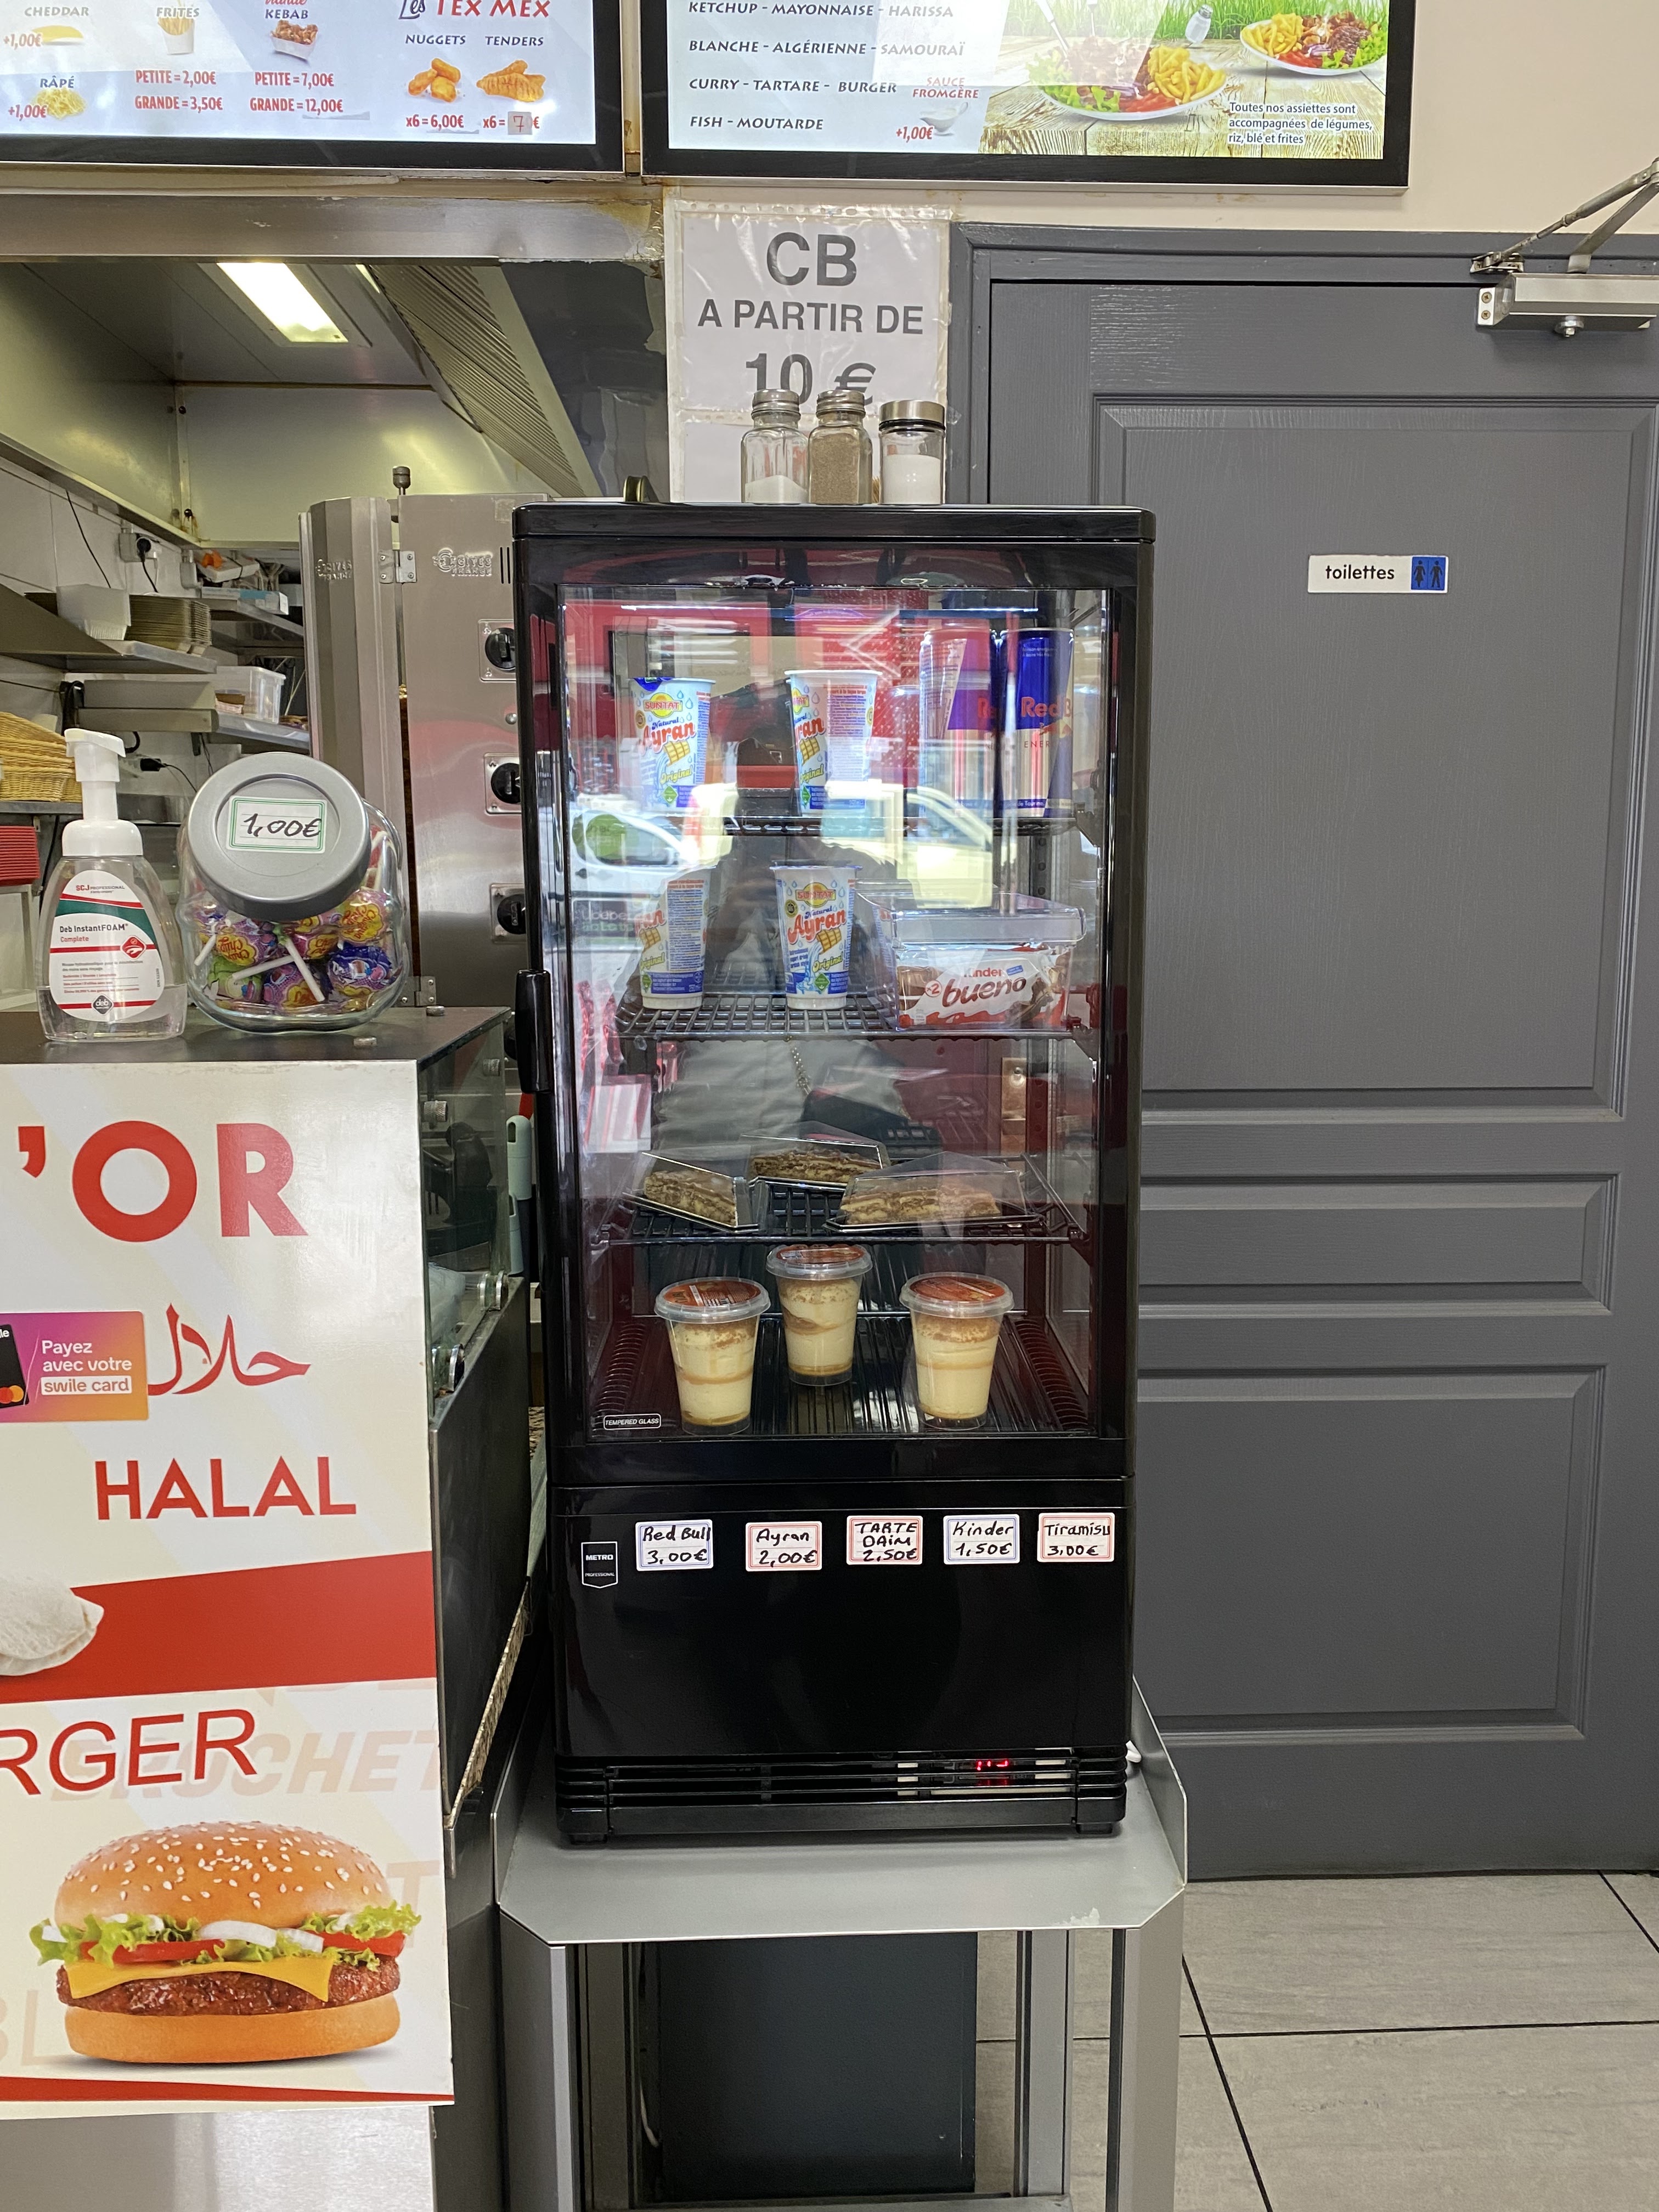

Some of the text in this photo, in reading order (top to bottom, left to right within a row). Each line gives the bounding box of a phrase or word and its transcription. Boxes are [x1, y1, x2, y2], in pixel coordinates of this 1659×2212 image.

[24, 7, 89, 18] CHEDDAR
[156, 7, 200, 18] FRITES
[265, 9, 308, 19] KEBAB
[489, 0, 550, 18] MEX
[689, 2, 758, 14] KETCHUP
[771, 3, 874, 16] MAYONNAISE
[888, 6, 953, 18] HARISSA
[3, 33, 42, 50] +1,00€
[405, 34, 466, 46] NUGGETS
[485, 36, 544, 47] TENDERS
[689, 40, 759, 53] BLANCHE
[772, 39, 867, 55] ALGÉRIENNE
[881, 42, 966, 57] SAMOURAÏ
[40, 76, 75, 89] RÂPÉ
[136, 70, 172, 84] PETITE
[182, 71, 216, 89] 2,00€
[255, 72, 291, 86] PETITE
[301, 73, 334, 90] 7,00€
[689, 78, 740, 91] CURRY
[753, 79, 820, 92] TARTARE
[838, 82, 898, 94] BURGER
[927, 77, 966, 87] SAUCE
[912, 85, 979, 99] FROMGÈRE
[8, 104, 47, 120] +1,00€
[134, 95, 180, 110] GRANDE
[190, 98, 223, 114] 3,50€
[250, 97, 295, 111] GRANDE
[305, 99, 343, 116] 12,00€
[1229, 102, 1356, 114] Toutes nos assiettes sont
[406, 117, 420, 128] x6
[430, 115, 464, 131] 6,00€
[483, 115, 496, 128] x6
[690, 116, 723, 128] FISH
[737, 116, 823, 130] MOUTARDE
[1229, 119, 1372, 131] accompagnées de légumes,
[896, 126, 934, 143] +1,00€
[1228, 133, 1304, 144] riz, blé et frites
[766, 232, 857, 286] CB
[697, 298, 924, 335] A PARTIR DE
[746, 353, 877, 405] 10 €
[1325, 564, 1395, 580] toilettes
[645, 701, 680, 710] SUNTAT
[1020, 694, 1060, 718] Red
[652, 716, 679, 730] Natural
[641, 721, 696, 755] Ayran
[659, 764, 693, 785] Original
[244, 812, 323, 838] 1,00€
[797, 891, 834, 899] SUNTAT
[804, 905, 833, 919] Natural
[787, 909, 847, 944] Ayran
[812, 951, 844, 973] Original
[942, 977, 1027, 1008] bueno
[95, 998, 110, 1007] deb
[42, 1340, 93, 1357] Payez
[43, 1357, 132, 1372] avec votre
[44, 1378, 129, 1392] swile card
[605, 1417, 659, 1426] TEMPERED GLASS
[95, 1455, 357, 1520] HALAL
[642, 1525, 712, 1542] Red Bull
[854, 1522, 918, 1534] TARTE
[952, 1521, 1014, 1536] Kinder
[1044, 1523, 1111, 1537] Tiramisu
[755, 1528, 809, 1547] Ayran
[647, 1548, 708, 1565] 3,00€
[758, 1549, 818, 1567] 2,00€
[955, 1543, 1012, 1557] 1,50€
[1047, 1545, 1099, 1557] 3,00€
[0, 1708, 258, 1796] RGER
